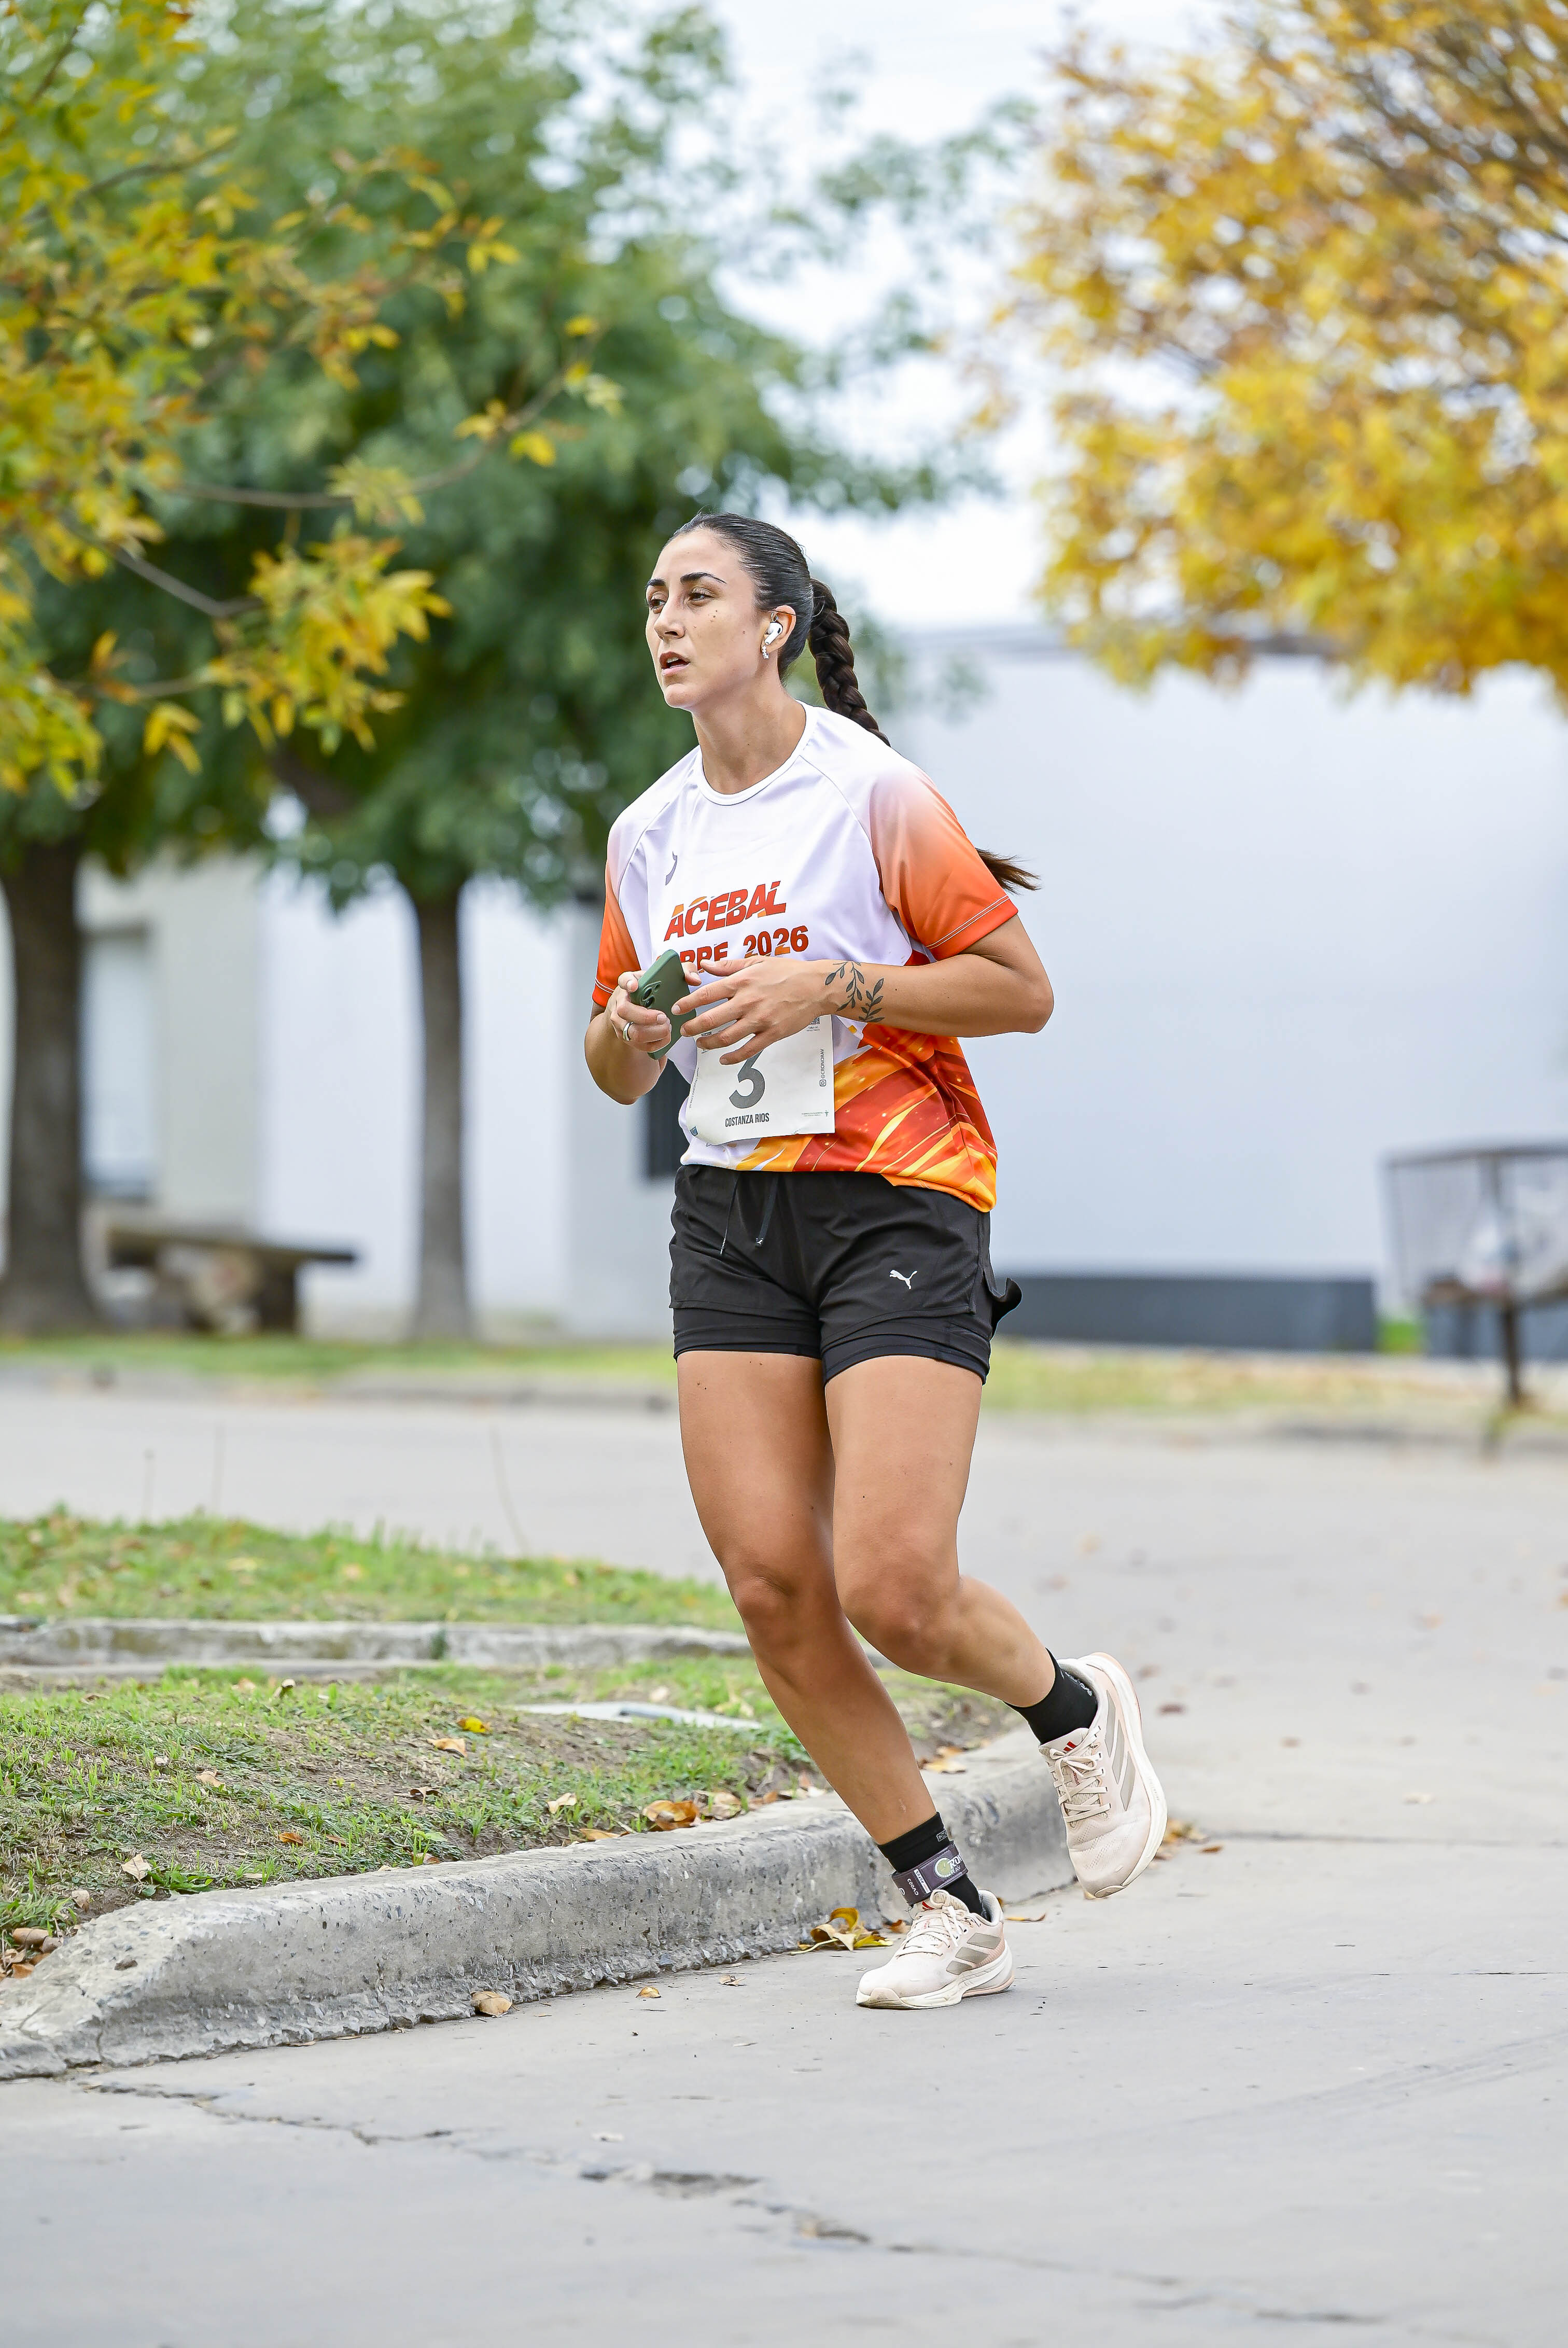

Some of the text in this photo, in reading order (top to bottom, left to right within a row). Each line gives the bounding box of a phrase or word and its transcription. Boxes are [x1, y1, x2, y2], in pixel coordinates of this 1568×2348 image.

[664, 880, 786, 942] ACEBAL
[743, 925, 808, 959] 2026
[729, 1050, 765, 1109] 3
[725, 1113, 769, 1127] COSTANZA RIOS
[907, 1878, 919, 1896] CV003
